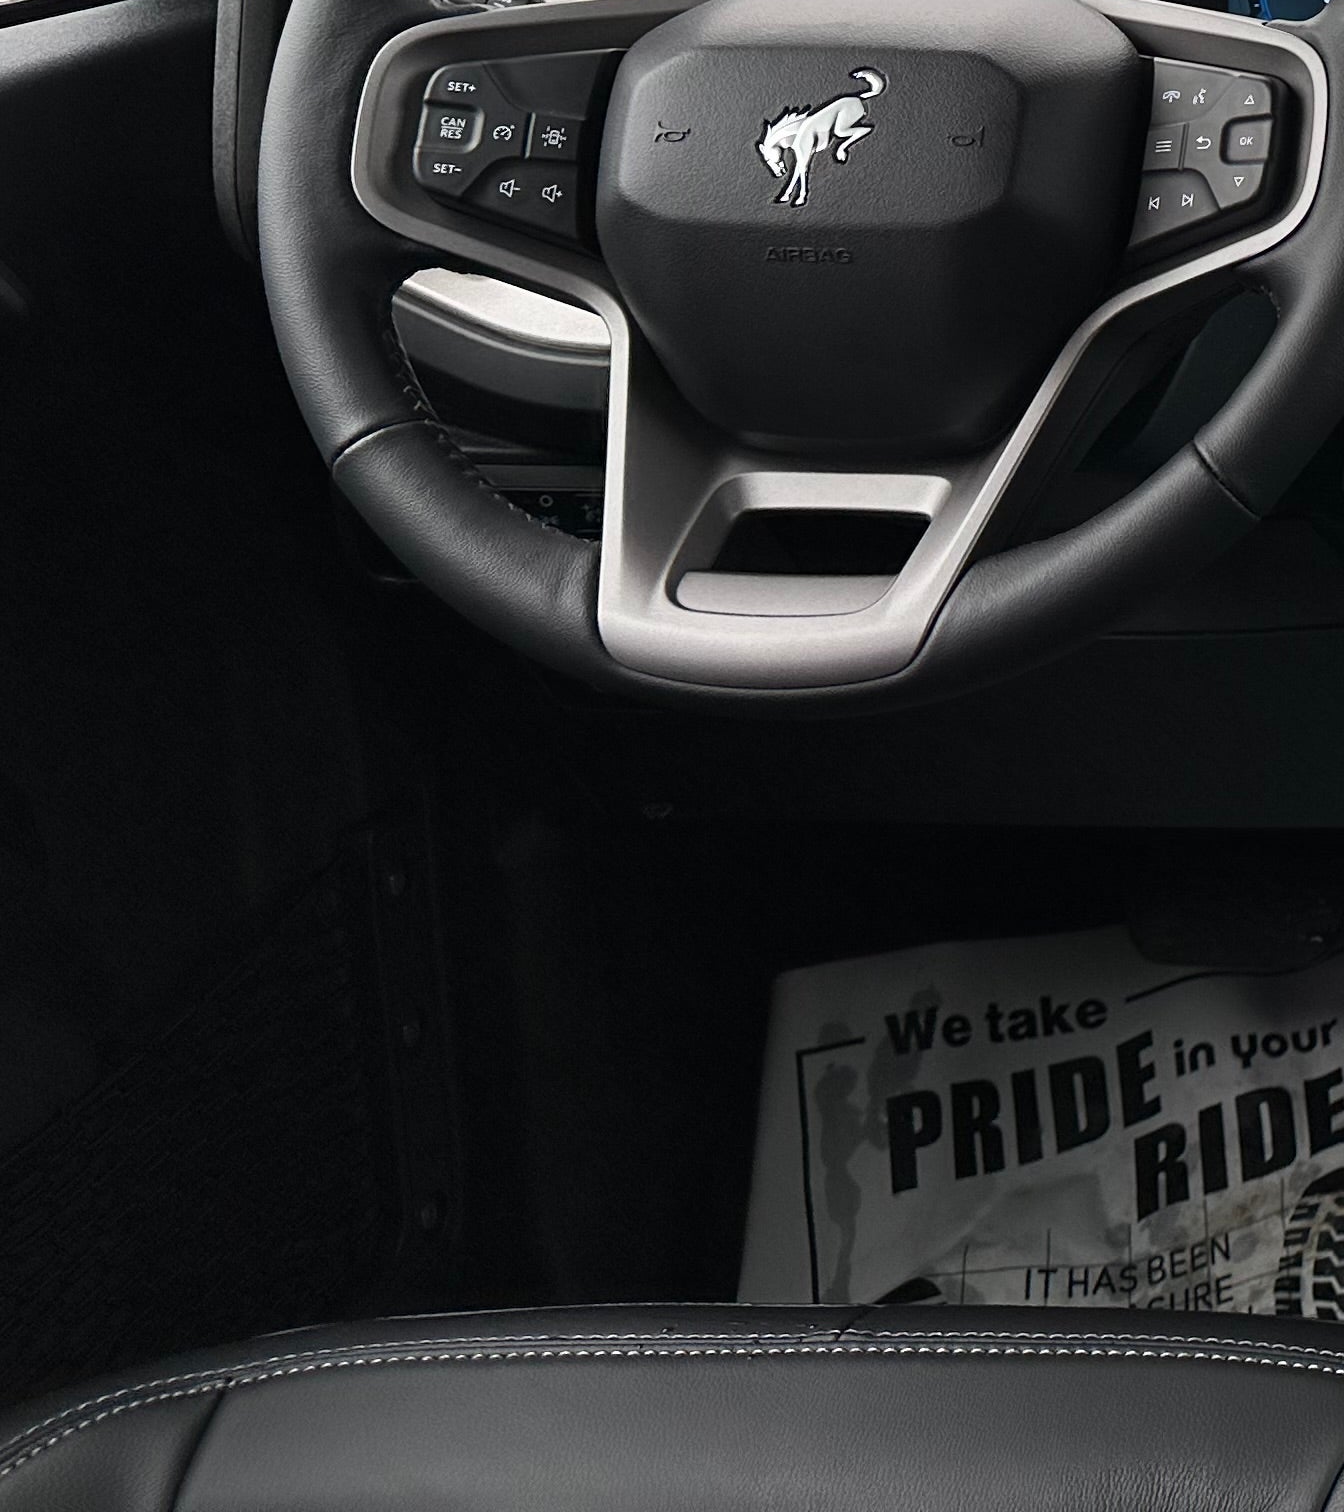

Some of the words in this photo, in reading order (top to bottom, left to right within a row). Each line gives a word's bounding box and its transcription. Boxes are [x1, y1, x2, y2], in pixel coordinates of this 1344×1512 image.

[448, 81, 476, 93] SET+
[441, 117, 466, 128] CAN
[440, 128, 463, 139] RES
[1240, 136, 1254, 146] OK
[766, 246, 852, 264] AIRBAG
[885, 1003, 974, 1055] We
[989, 995, 1108, 1046] take
[886, 1029, 1162, 1195] PRIDE
[1174, 1039, 1216, 1077] in
[1231, 1019, 1338, 1070] your
[1025, 1268, 1058, 1300] IT
[1068, 1265, 1138, 1298] HAS
[1148, 1233, 1231, 1285] BEEN
